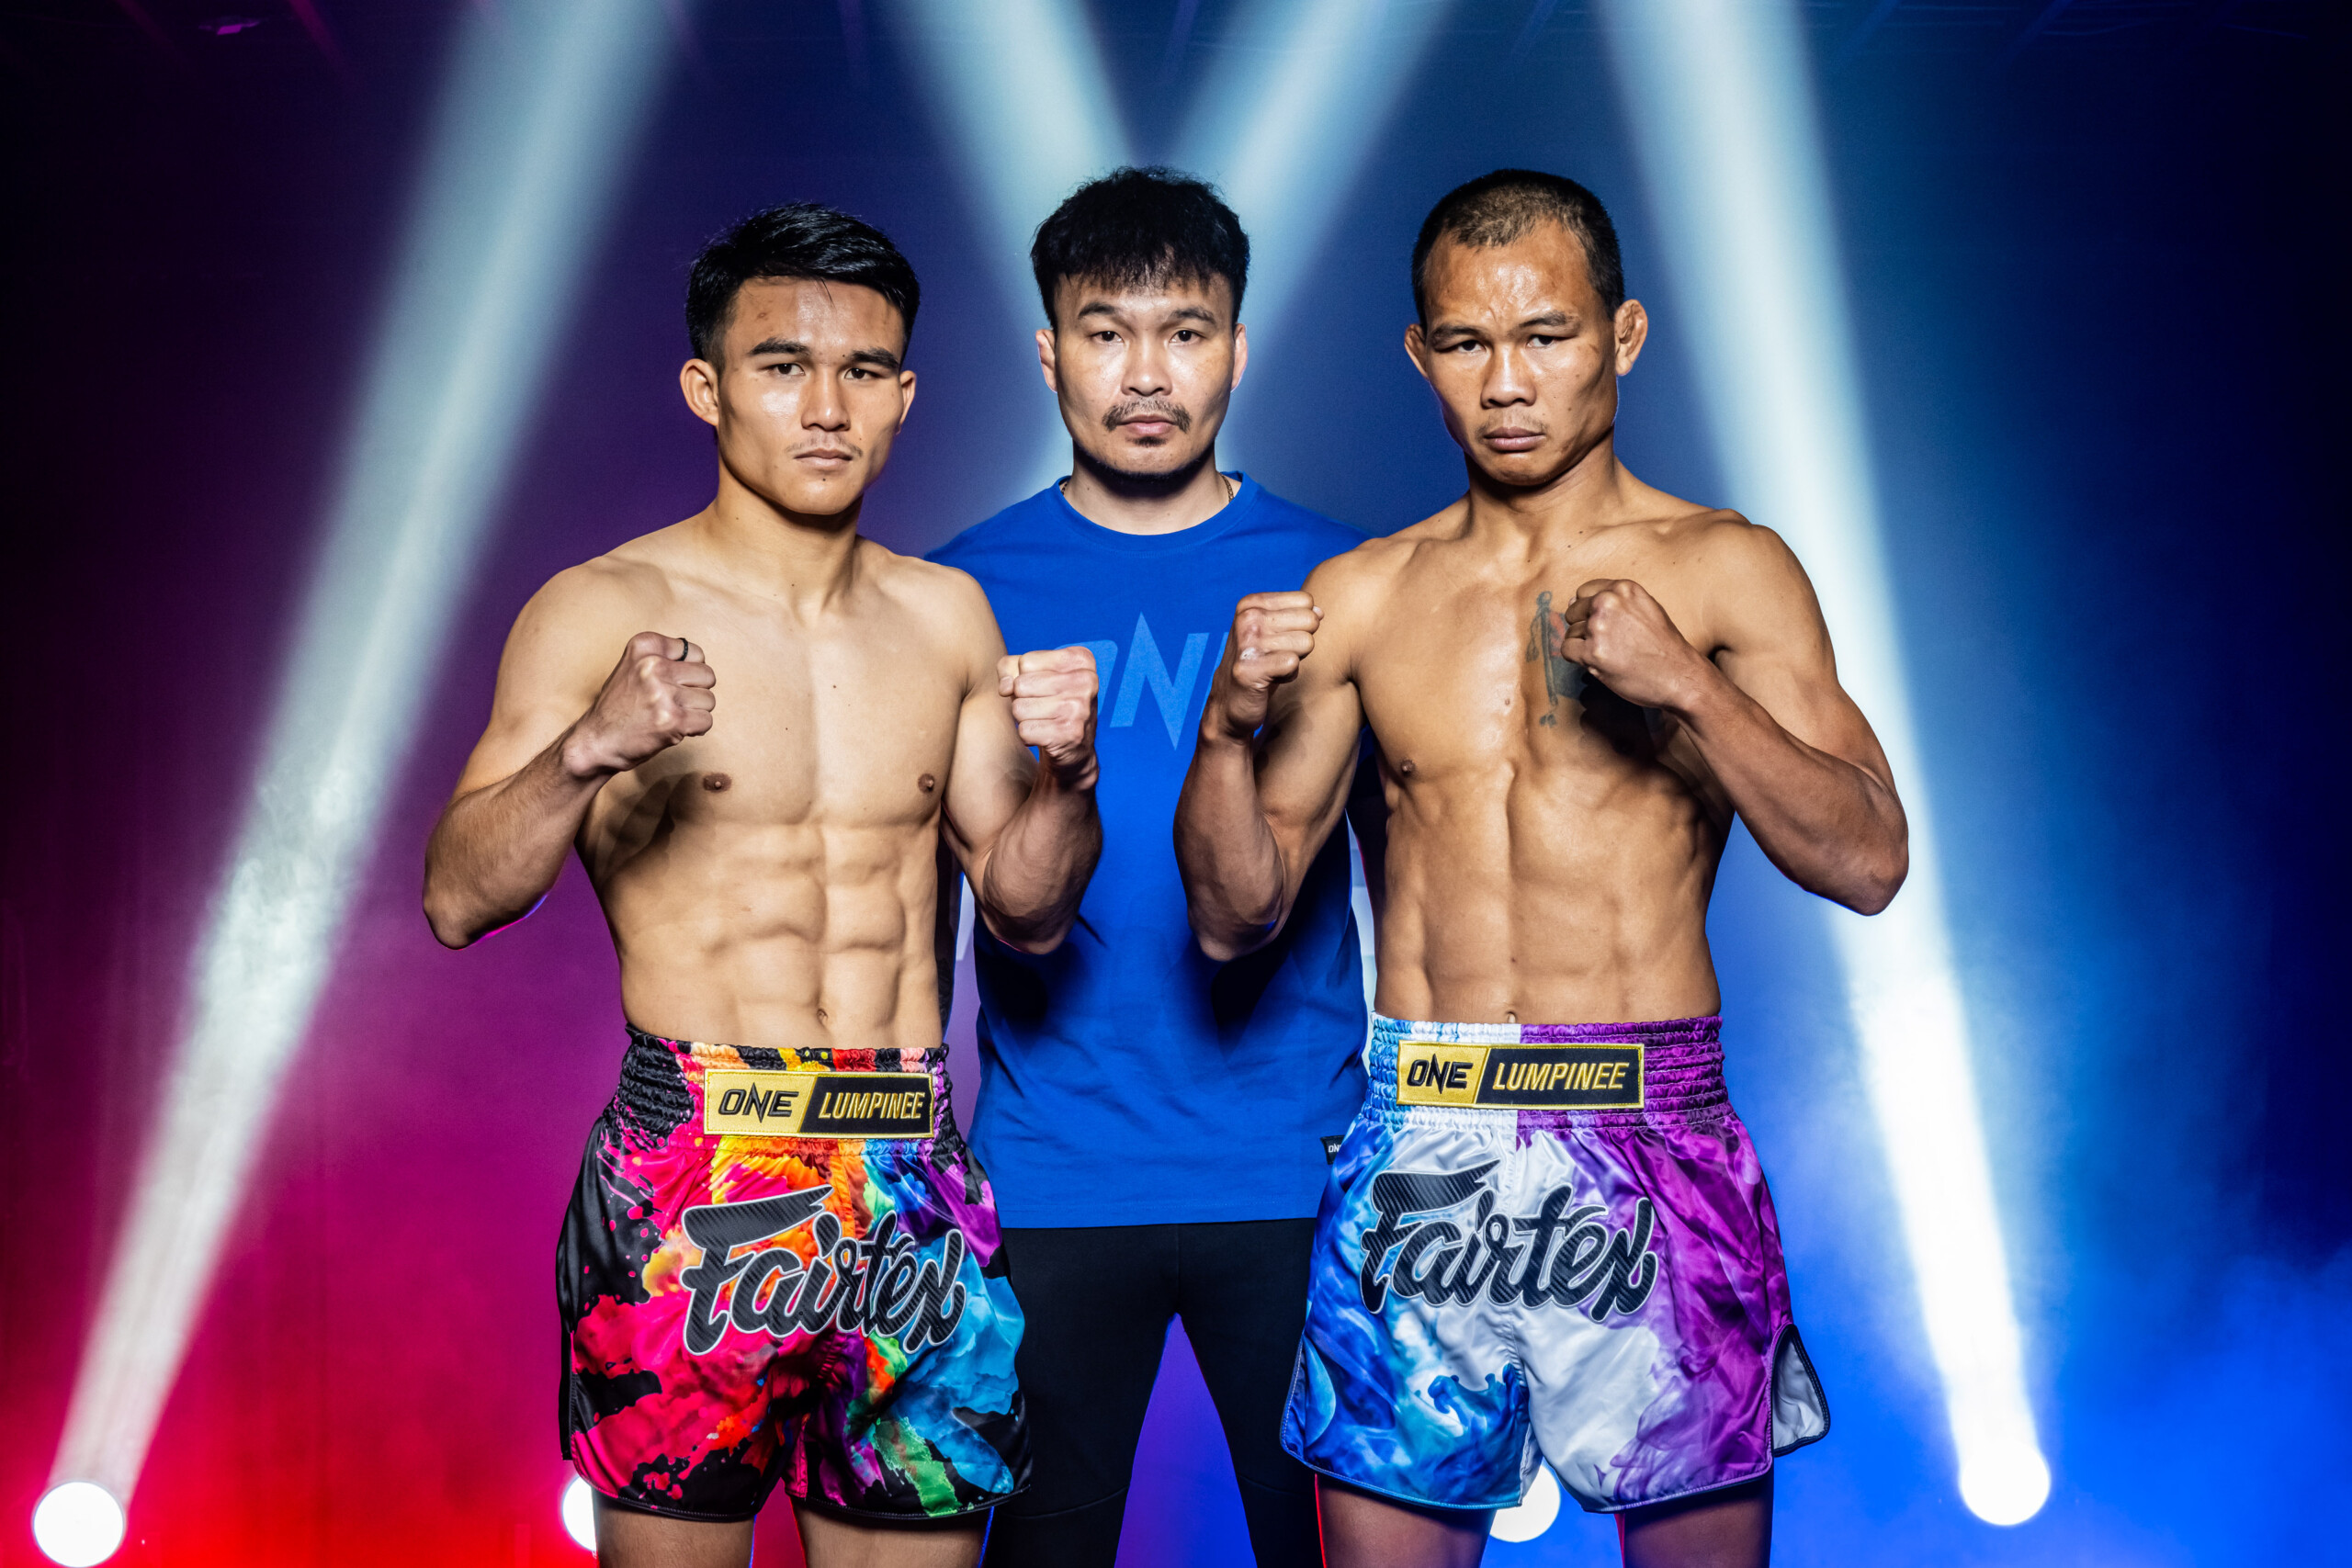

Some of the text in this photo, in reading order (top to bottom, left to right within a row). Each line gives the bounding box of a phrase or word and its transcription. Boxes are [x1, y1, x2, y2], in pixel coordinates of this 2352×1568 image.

[1407, 1054, 1630, 1094] ONE LUMPINEE
[718, 1082, 925, 1123] ONE LUMPINEE
[1328, 1143, 1341, 1153] ON
[1360, 1159, 1658, 1323] Fairtex
[679, 1184, 967, 1356] Fairtex
